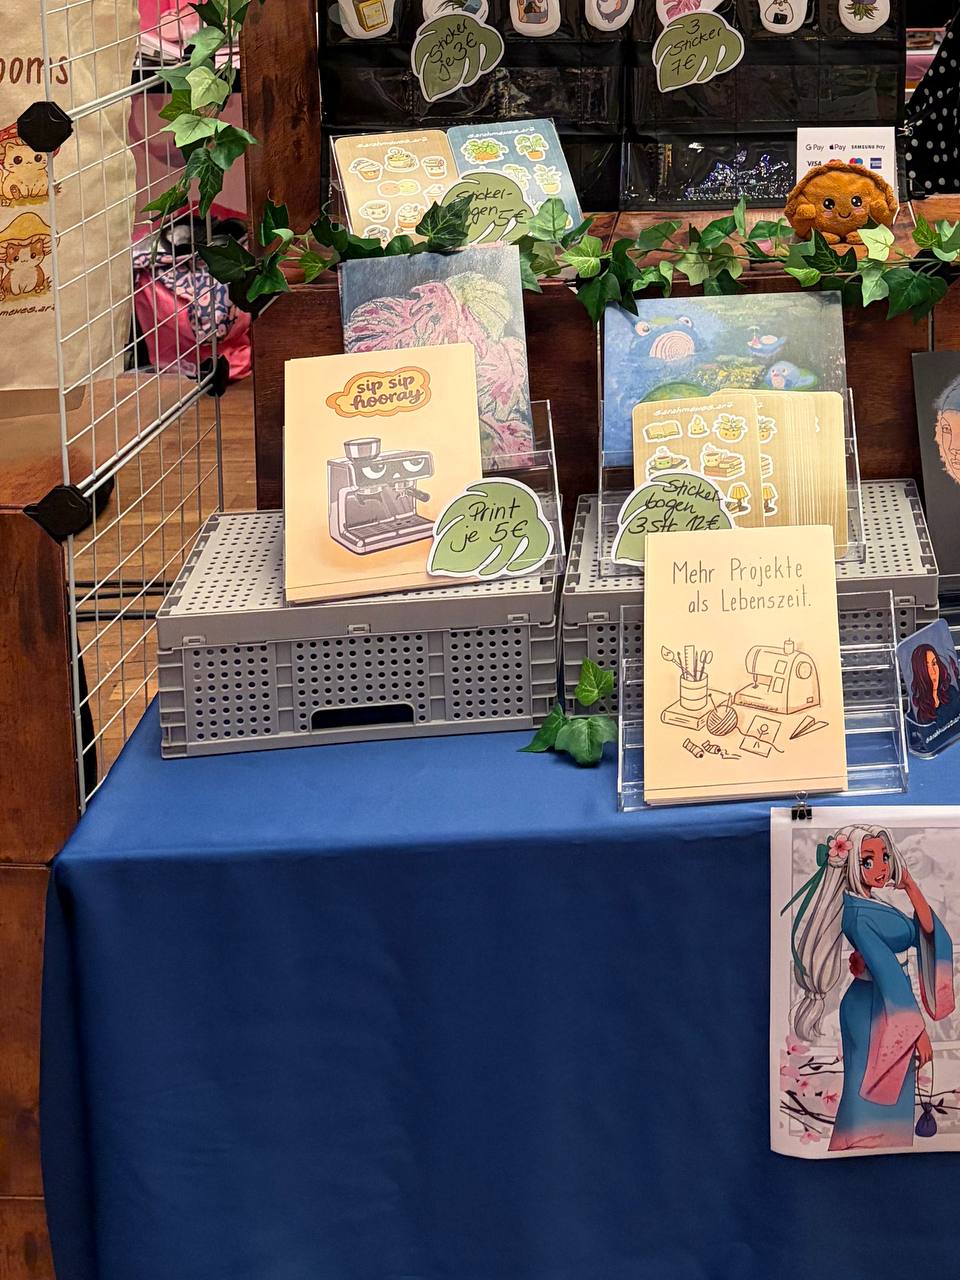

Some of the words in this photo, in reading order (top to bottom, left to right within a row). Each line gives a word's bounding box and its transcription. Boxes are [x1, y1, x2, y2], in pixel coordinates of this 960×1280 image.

[686, 18, 700, 35] 3
[429, 18, 468, 64] Sticker
[453, 31, 478, 61] 3€
[669, 27, 722, 56] Sticker
[671, 53, 697, 76] 7€
[813, 143, 825, 152] Pay
[834, 143, 847, 152] Pay
[356, 379, 384, 396] sip
[388, 374, 415, 390] sip
[349, 388, 425, 411] hooray
[468, 496, 521, 522] Print
[645, 492, 696, 521] bogen
[450, 525, 480, 553] je
[489, 520, 528, 544] 5€
[672, 560, 715, 585] Mehr
[730, 555, 803, 587] Projekte
[688, 590, 709, 613] als
[721, 584, 812, 612] Lebenszeit.
